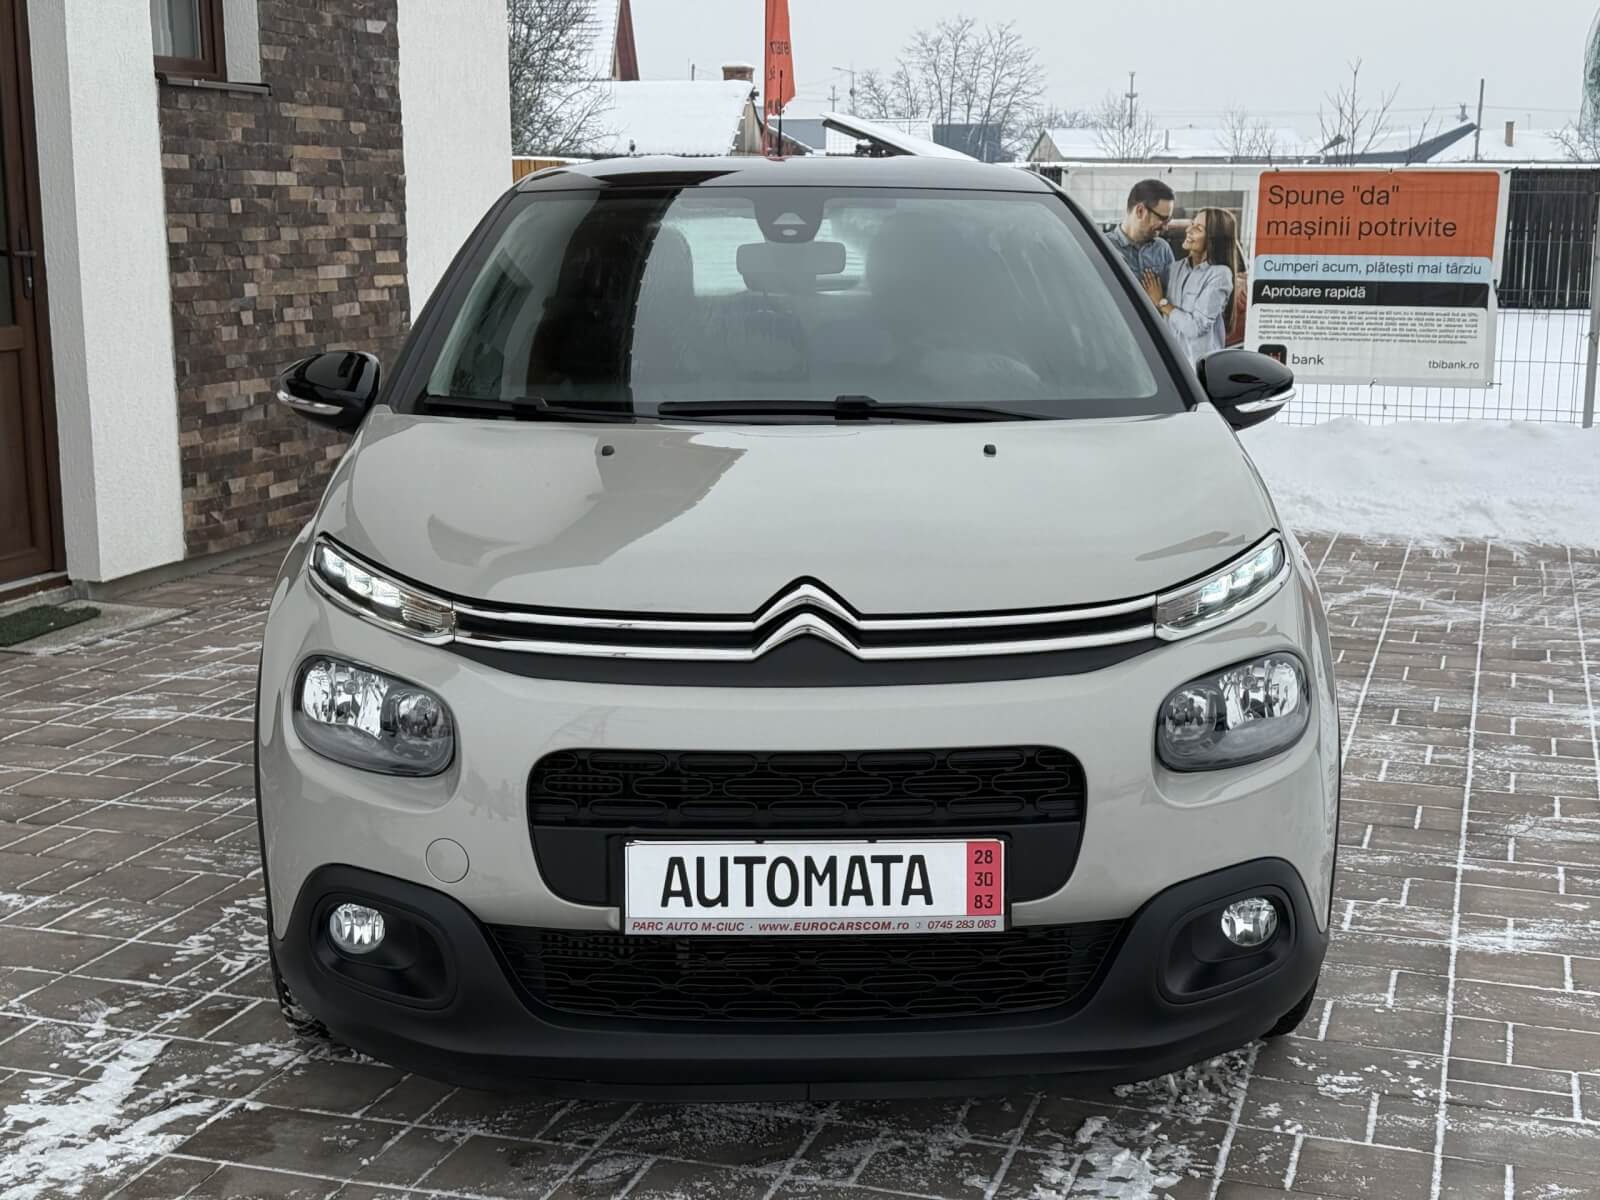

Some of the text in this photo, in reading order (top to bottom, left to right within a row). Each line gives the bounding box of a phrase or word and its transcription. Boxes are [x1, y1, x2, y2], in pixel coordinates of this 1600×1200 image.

[1268, 185, 1400, 208] Spune "da"
[1266, 217, 1457, 240] mașinii potrivite
[1263, 260, 1482, 276] Cumperi acum, plătești mai târziu
[1261, 285, 1366, 300] Aprobare rapidă
[1291, 353, 1324, 366] bank
[1428, 359, 1480, 370] tbibank.ro
[974, 850, 993, 865] 28
[660, 854, 934, 908] AUTOMATA
[974, 872, 993, 887] 30
[974, 894, 993, 909] 83
[631, 919, 997, 932] PARC AUTO M-CIUC www.EUROCARSCOM.ro 0745 283 083
